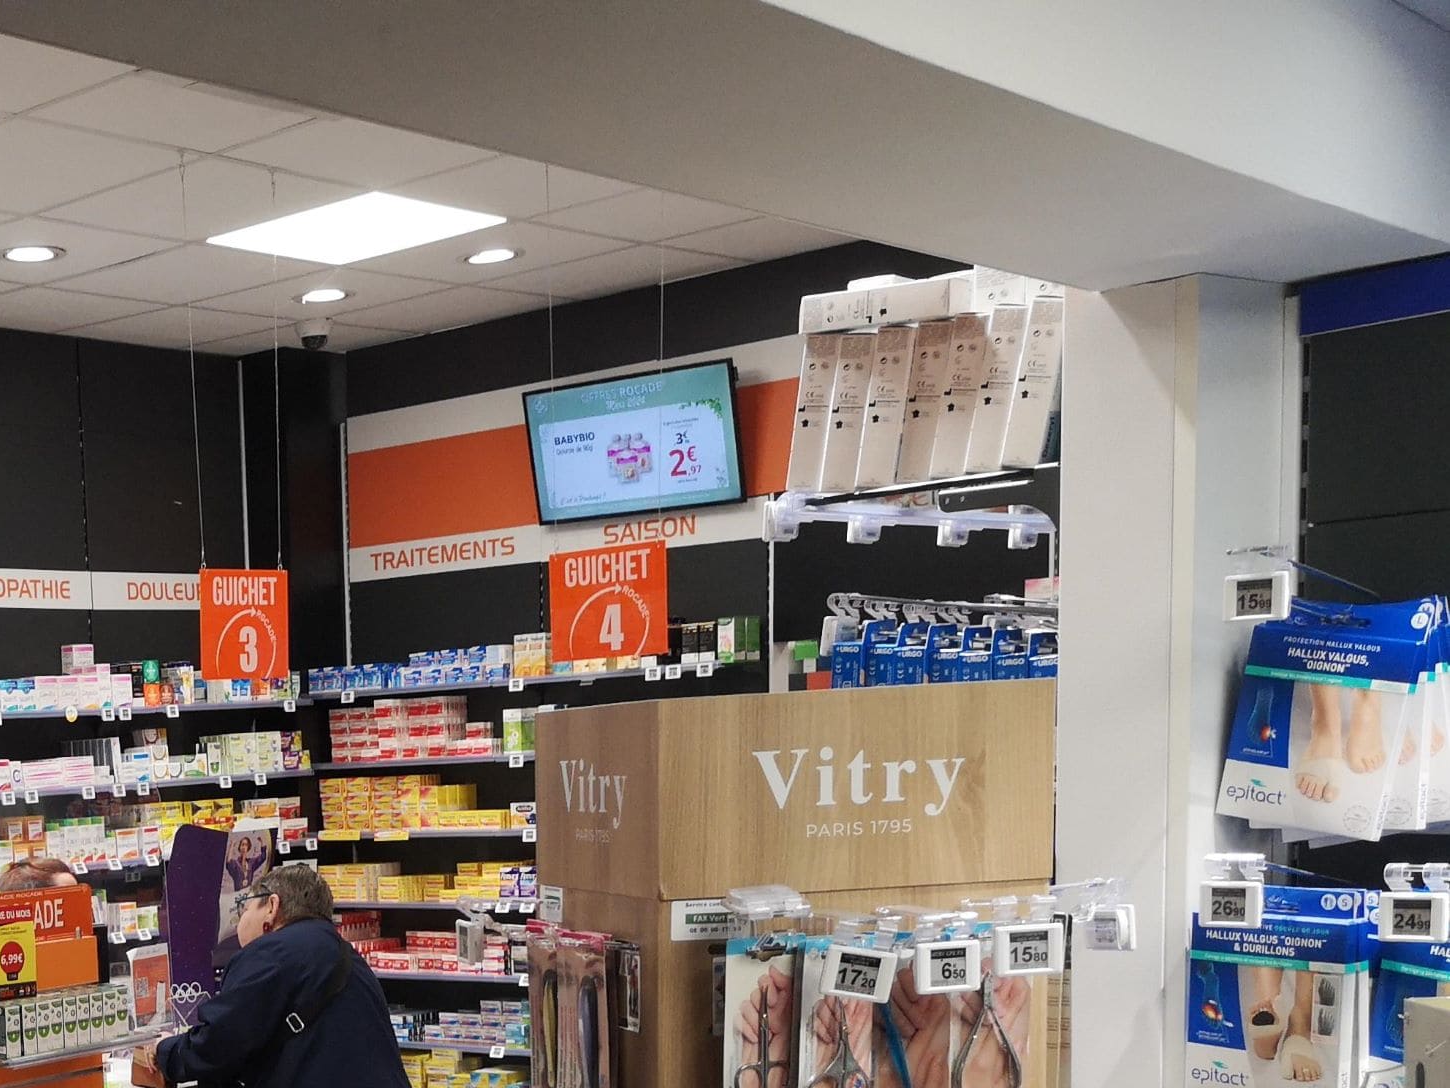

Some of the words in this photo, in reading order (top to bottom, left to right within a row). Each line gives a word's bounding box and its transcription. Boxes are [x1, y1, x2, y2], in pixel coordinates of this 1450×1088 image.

[554, 432, 595, 446] BABYBIO
[603, 514, 697, 545] SAISON
[370, 536, 515, 571] TRAITEMENTS
[564, 547, 651, 588] GUICHET
[211, 576, 278, 607] GUICHET
[599, 603, 625, 652] 4
[238, 626, 258, 673] 3
[843, 646, 859, 654] URGO
[873, 647, 894, 655] URGO
[1283, 636, 1325, 646] PROTECTION
[1326, 641, 1353, 650] HALLUX
[1354, 644, 1381, 653] VALGUS
[904, 650, 923, 658] URGO
[938, 652, 959, 660] URGO
[968, 655, 988, 663] URGO
[1002, 657, 1025, 666] URGO
[1287, 647, 1326, 660] HALLUX
[1328, 652, 1369, 667] VALGUS,
[1038, 657, 1058, 667] URGO
[751, 745, 967, 817] Vitry
[558, 758, 627, 830] Vitry
[1226, 783, 1282, 806] epitact
[575, 828, 599, 842] PARIS
[806, 821, 863, 838] PARIS
[870, 818, 913, 835] 1795
[6, 909, 15, 919] DU
[16, 908, 31, 918] MOIS
[693, 914, 708, 922] FAX
[1205, 929, 1241, 941] HALLUX
[1242, 932, 1279, 944] VALGUS
[1242, 944, 1296, 958] DURILLONS
[0, 953, 23, 966] 6,99€
[1191, 1066, 1247, 1087] epitact
